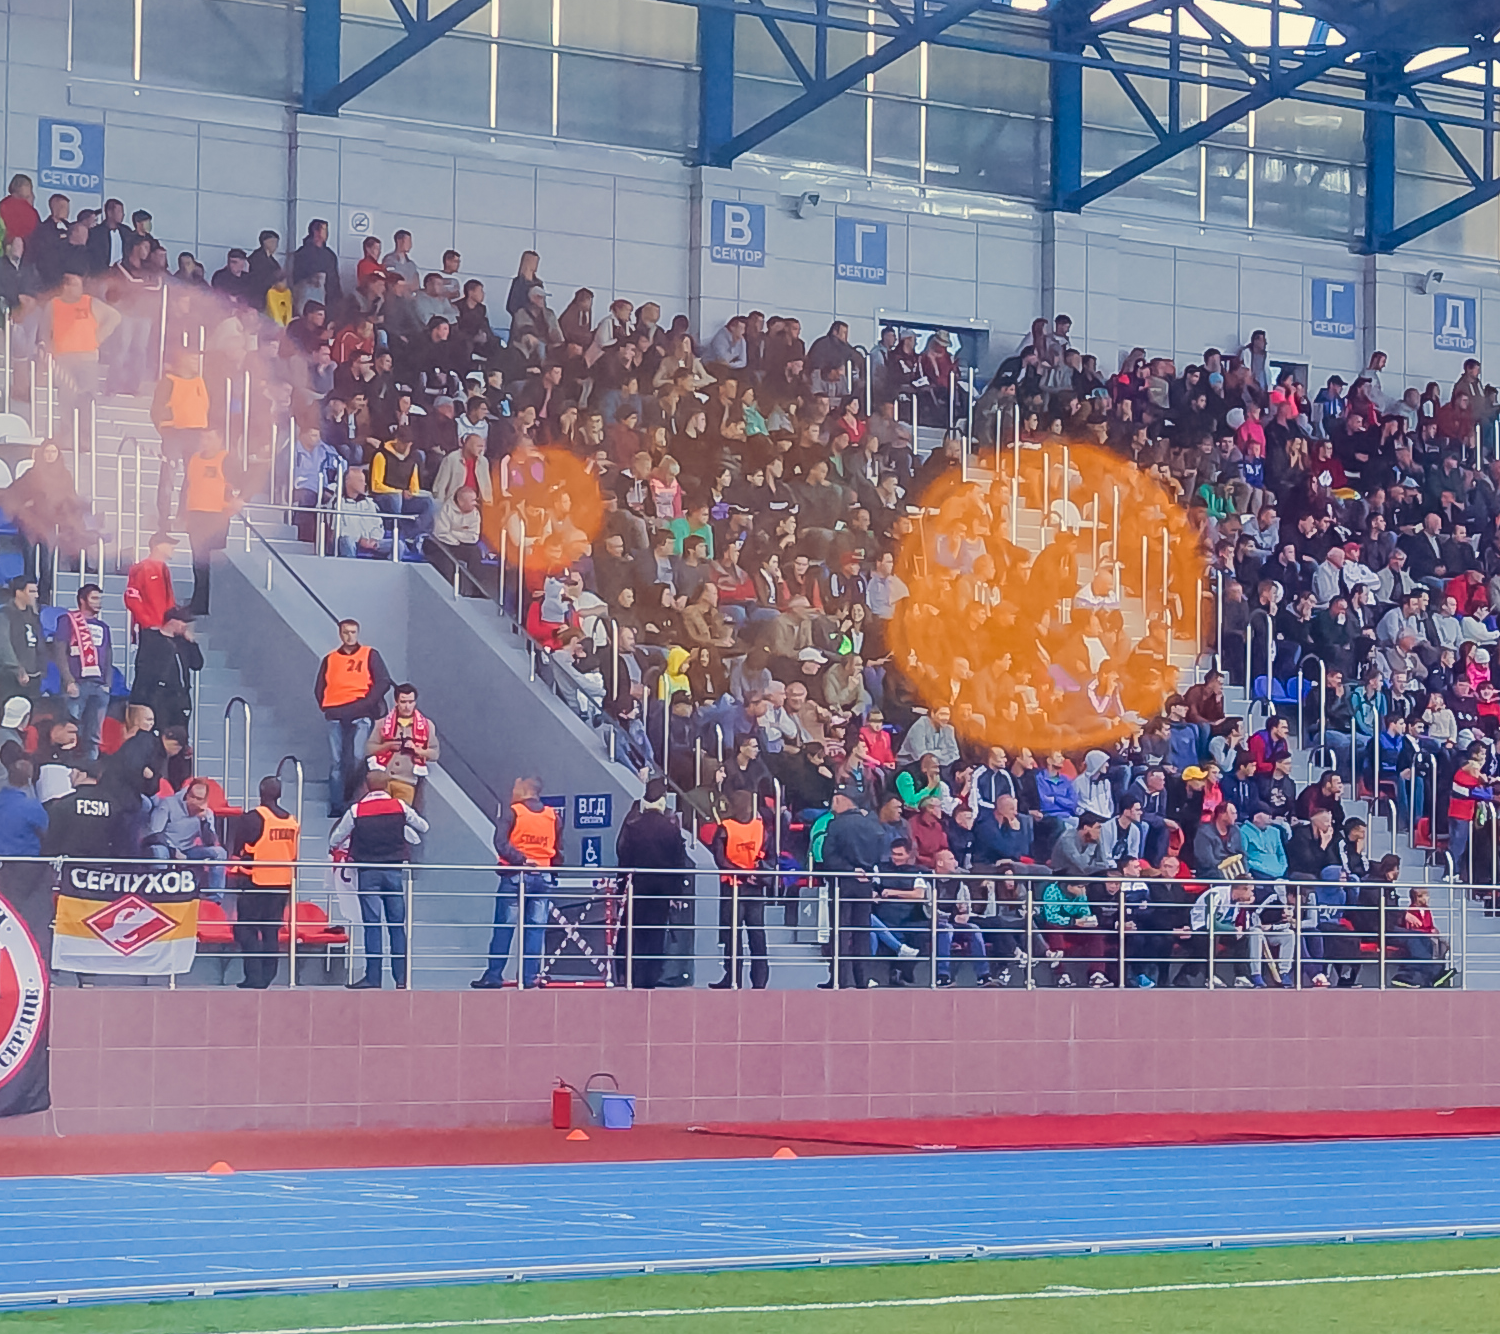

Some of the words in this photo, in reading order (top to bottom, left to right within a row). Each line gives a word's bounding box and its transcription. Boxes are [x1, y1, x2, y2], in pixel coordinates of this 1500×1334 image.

[50, 123, 84, 168] В
[41, 169, 99, 188] СЕКТОР
[723, 204, 752, 246] В
[712, 245, 762, 262] СЕКТОР
[855, 224, 876, 263] Г
[838, 264, 884, 279] СЕКТОР
[1326, 283, 1344, 319] Г
[1442, 298, 1466, 336] Д
[76, 799, 110, 817] FCSM
[71, 868, 196, 893] СЕРПУХОВ
